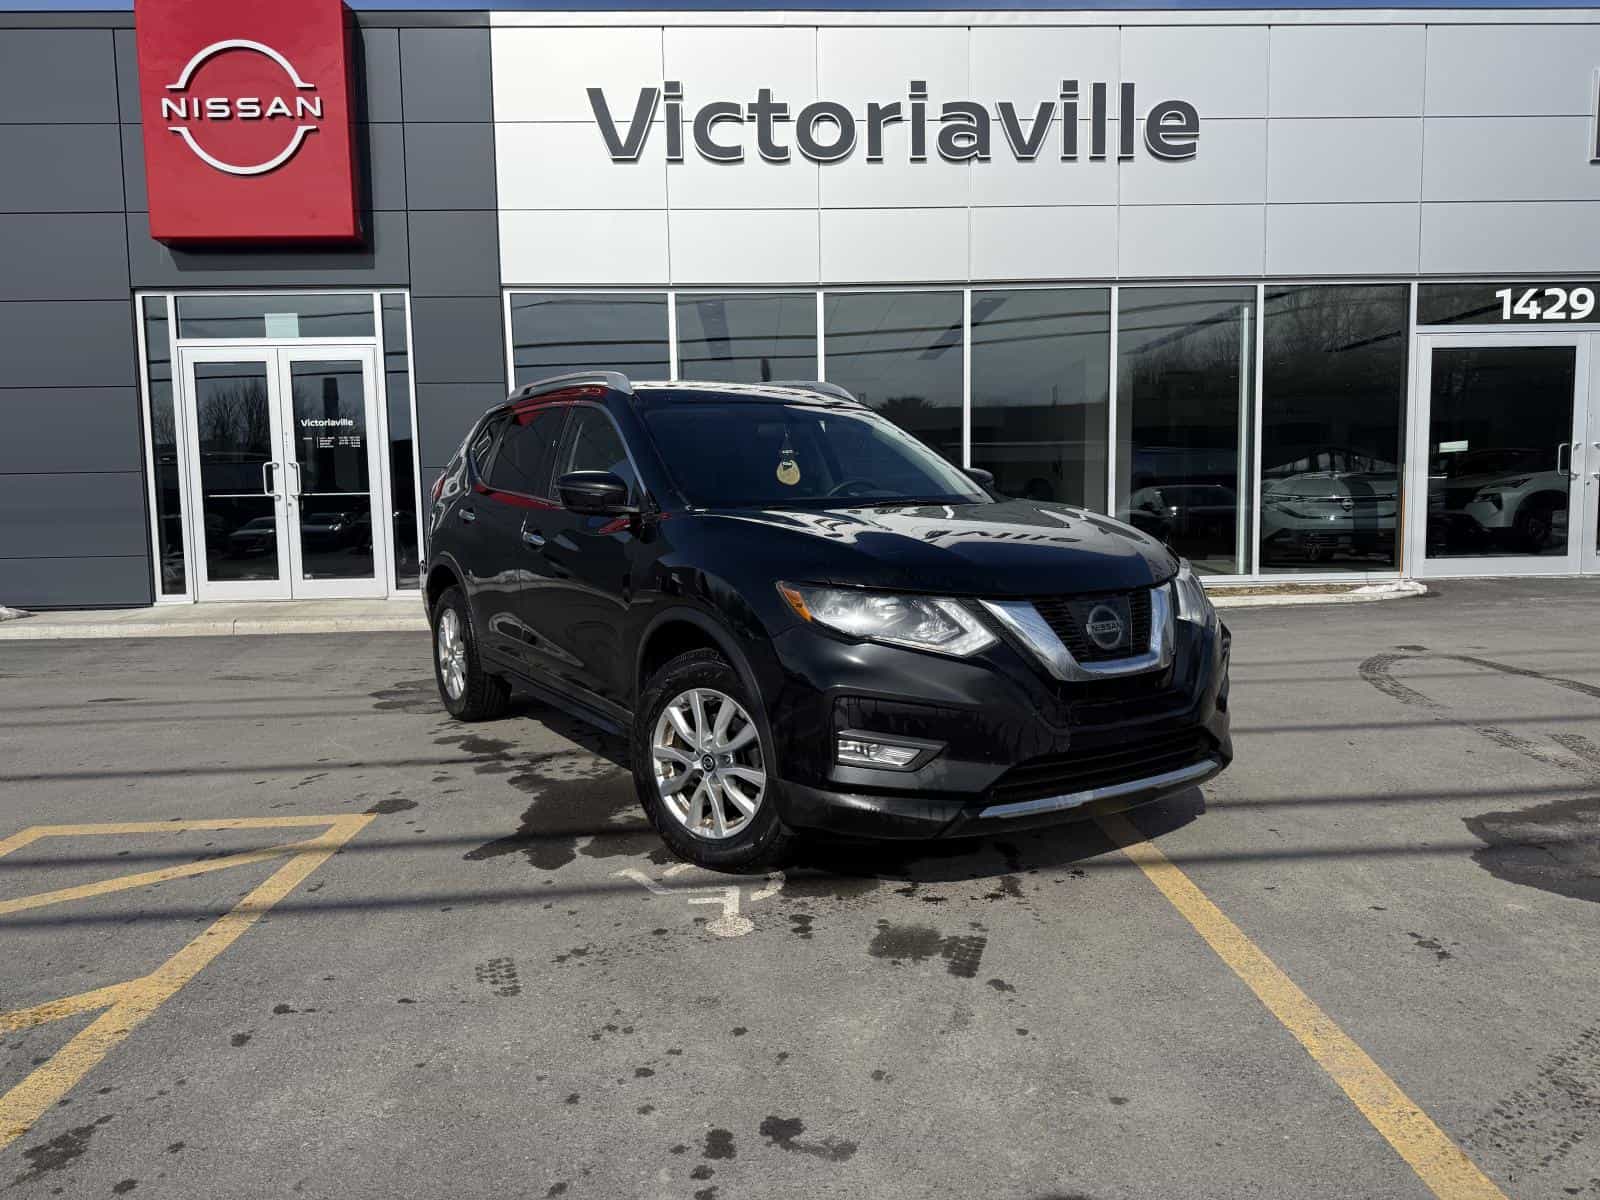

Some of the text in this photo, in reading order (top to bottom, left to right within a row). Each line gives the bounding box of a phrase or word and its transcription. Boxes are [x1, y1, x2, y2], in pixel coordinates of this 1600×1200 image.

[161, 96, 322, 119] NISSAN
[585, 79, 1201, 163] Victoriaville
[1495, 287, 1596, 321] 1429
[300, 418, 353, 427] Victoriaville
